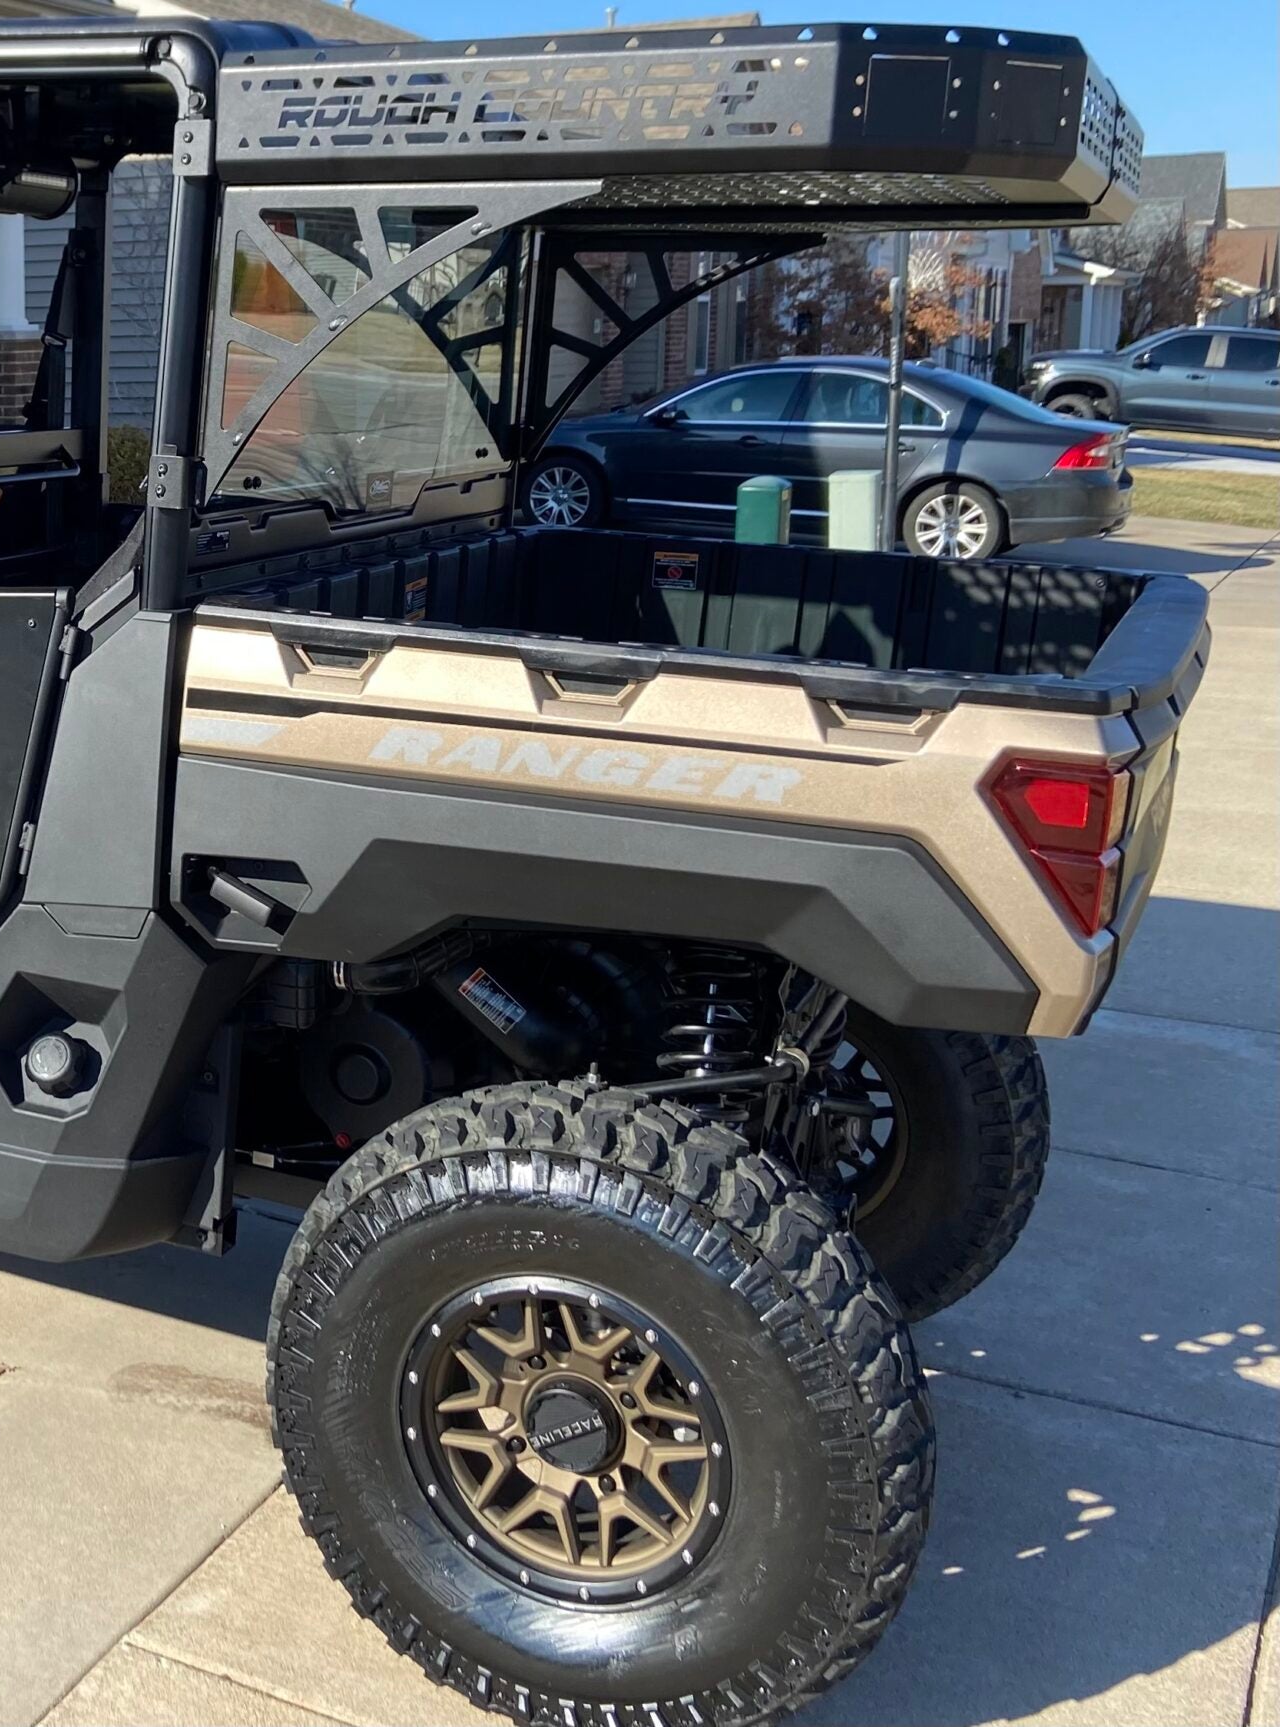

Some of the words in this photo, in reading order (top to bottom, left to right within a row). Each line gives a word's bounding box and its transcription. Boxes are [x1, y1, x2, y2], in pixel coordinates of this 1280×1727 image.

[278, 91, 462, 129] ROUGH
[473, 80, 759, 123] COUNTRY
[367, 727, 803, 805] RANGER
[529, 1414, 603, 1448] RACELINE
